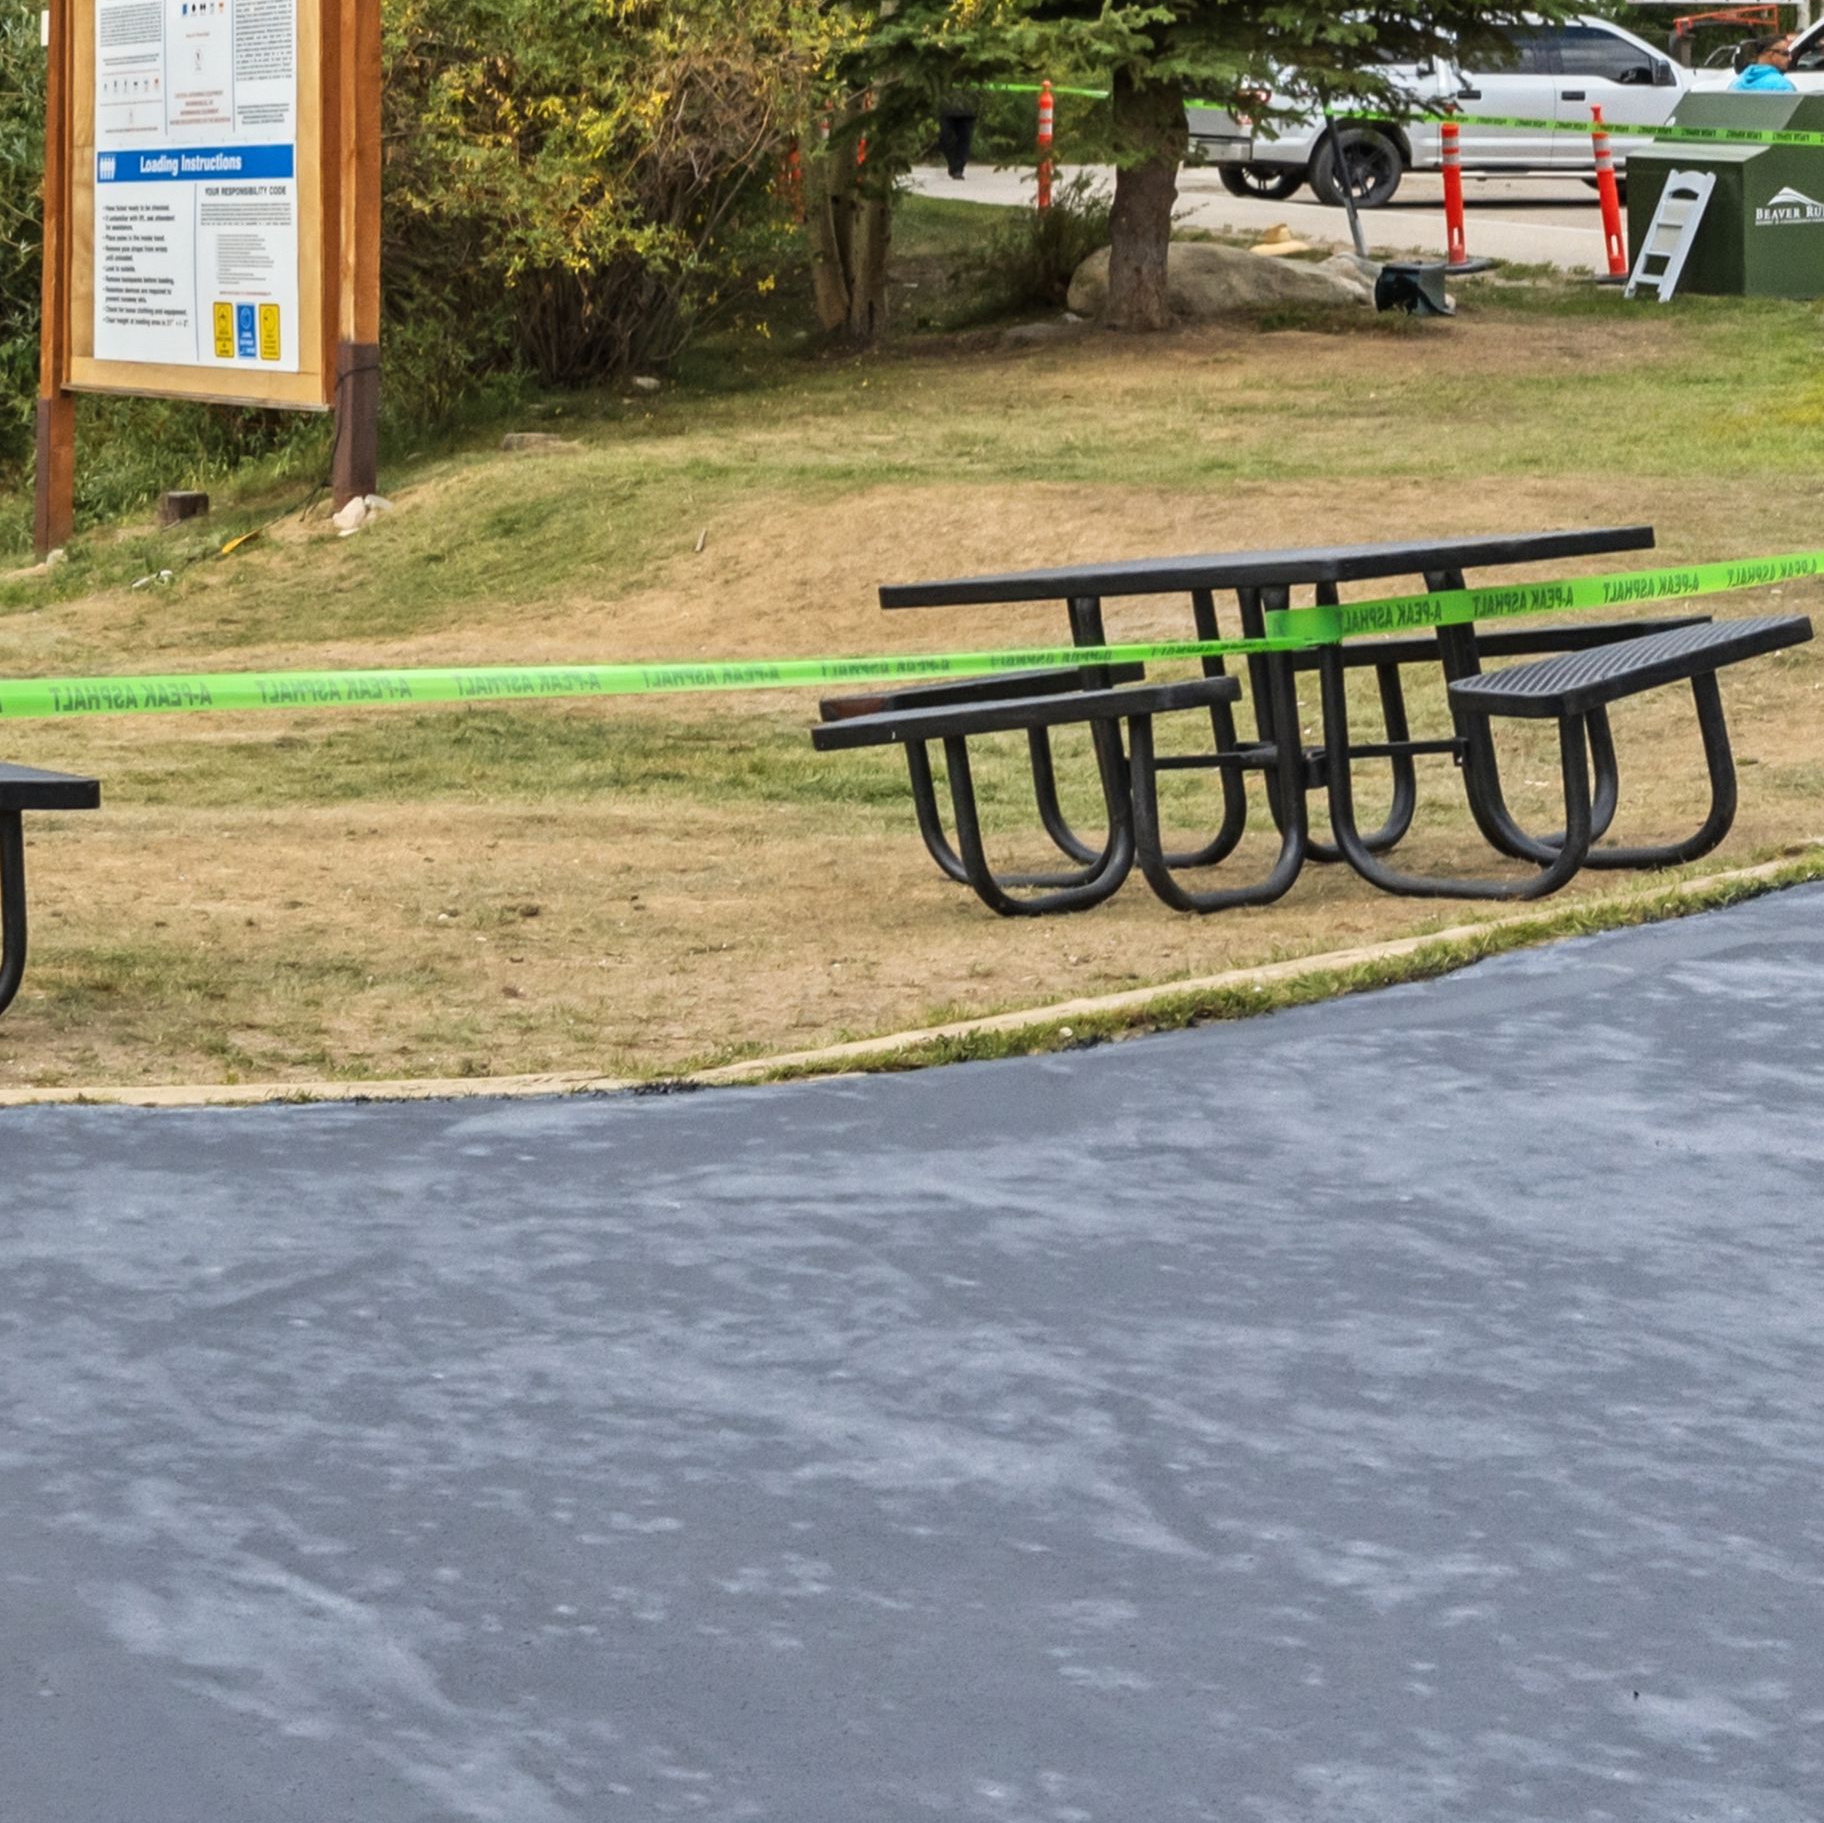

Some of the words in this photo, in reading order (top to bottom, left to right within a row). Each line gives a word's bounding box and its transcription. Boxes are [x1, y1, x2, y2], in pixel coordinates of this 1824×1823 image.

[140, 155, 179, 177] Loading
[181, 152, 242, 171] Instructions
[269, 185, 287, 195] CODE
[1756, 207, 1800, 220] BEAVER
